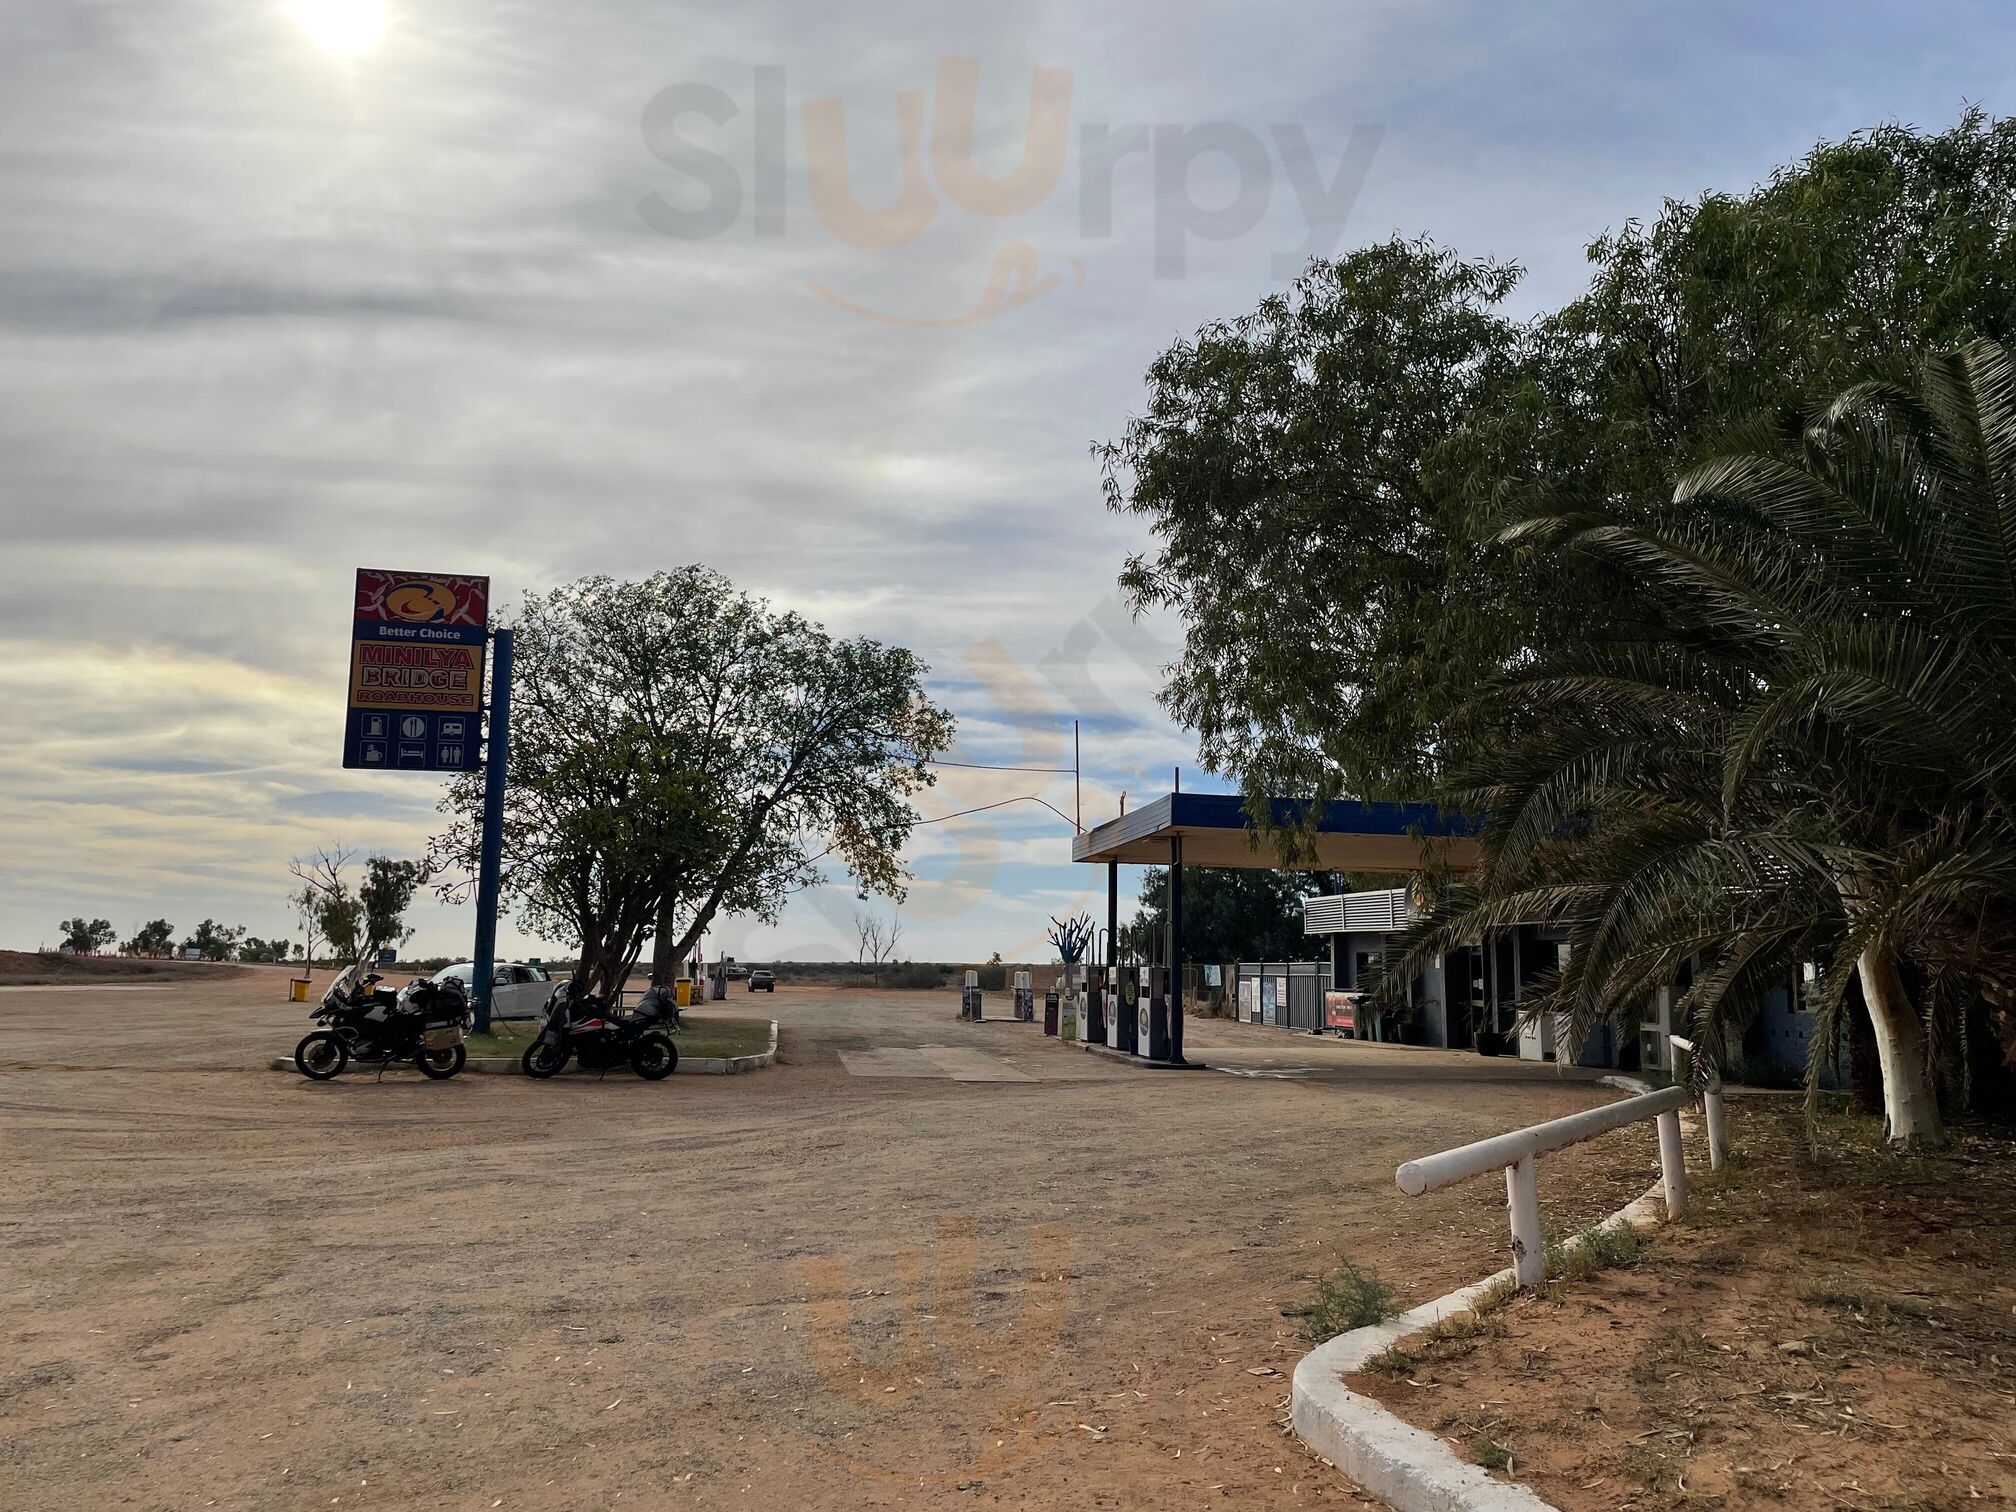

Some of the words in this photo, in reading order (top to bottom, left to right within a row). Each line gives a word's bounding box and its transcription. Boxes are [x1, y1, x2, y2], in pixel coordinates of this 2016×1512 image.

[379, 626, 417, 638] Better
[419, 628, 461, 640] Choice
[360, 643, 474, 670] MINILYA
[362, 666, 467, 690] BRIDGE
[357, 689, 473, 706] ROADHOUSE
